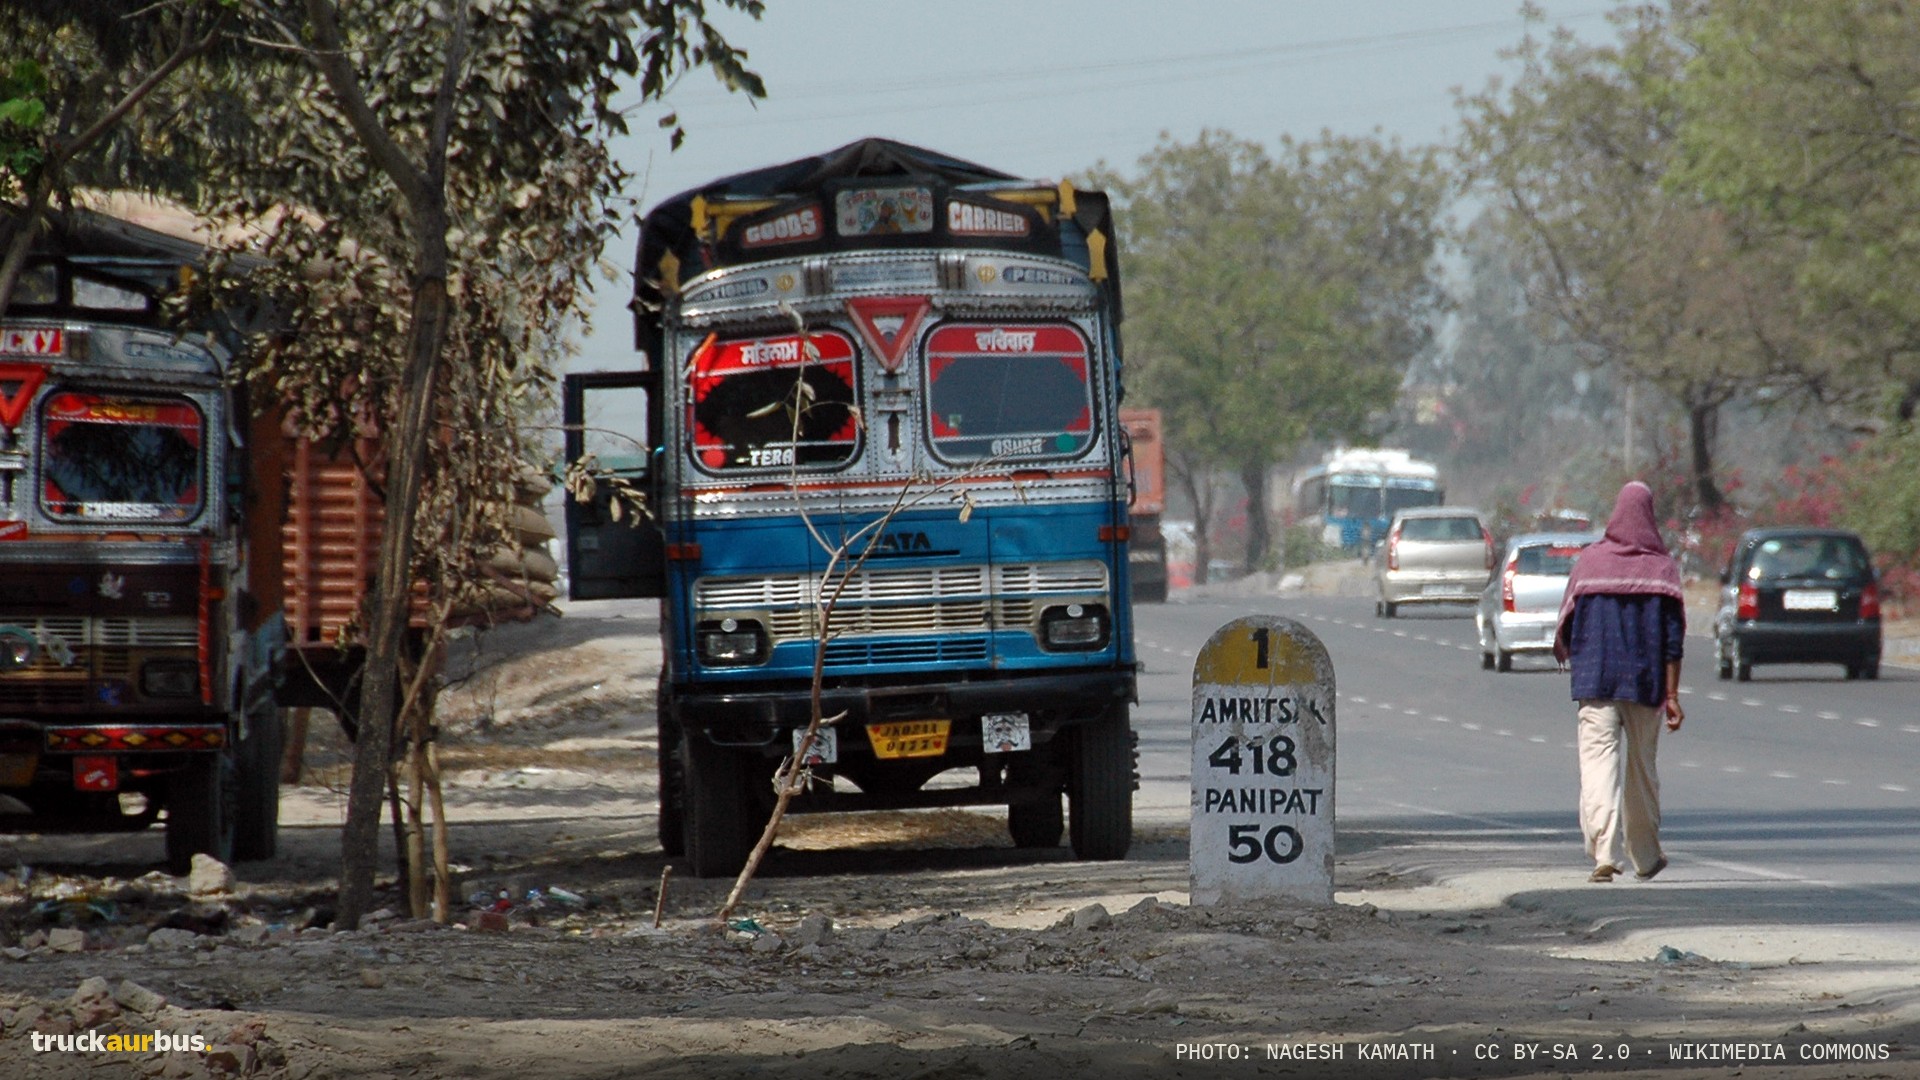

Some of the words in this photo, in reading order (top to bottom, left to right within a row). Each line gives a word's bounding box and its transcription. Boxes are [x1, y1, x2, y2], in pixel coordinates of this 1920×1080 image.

[745, 208, 818, 243] GOODS
[948, 200, 1026, 233] CARRIER
[692, 278, 767, 301] ATIONAL
[1013, 269, 1075, 285] PERMIT
[750, 449, 795, 467] TERA
[867, 532, 931, 551] TATA
[1252, 628, 1269, 669] 1
[1208, 735, 1298, 777] 418
[1205, 788, 1323, 815] PANIPAT
[1228, 824, 1304, 865] 50
